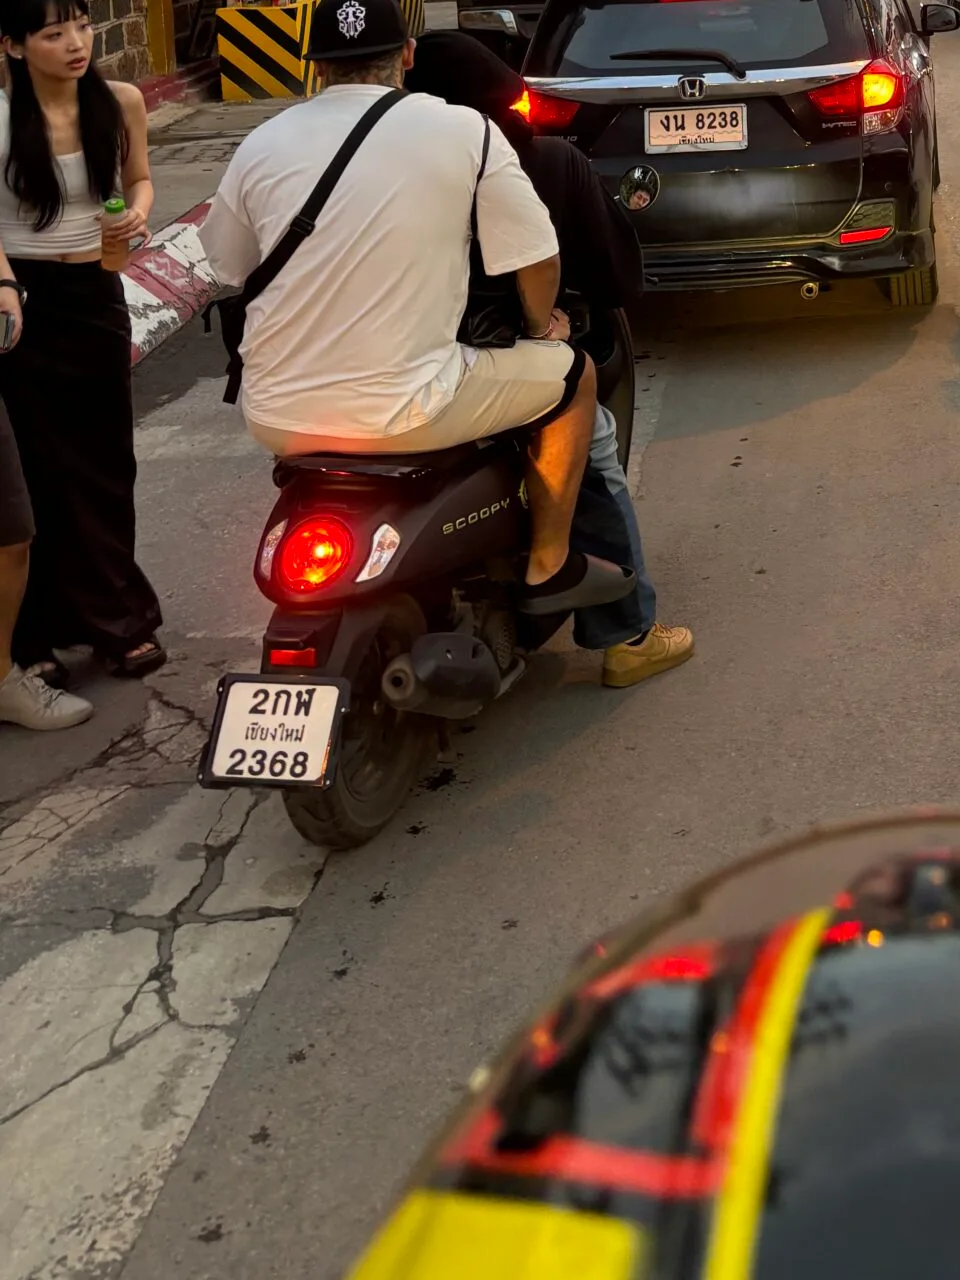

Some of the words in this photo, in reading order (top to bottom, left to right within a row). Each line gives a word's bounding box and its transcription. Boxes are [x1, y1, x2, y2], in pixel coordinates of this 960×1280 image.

[660, 113, 685, 131] งน
[696, 111, 739, 130] 8238
[679, 134, 715, 144] เชียงใหม่
[442, 497, 510, 535] SCOOPY
[244, 721, 305, 743] เชียงใหม่
[225, 748, 309, 779] 2368
